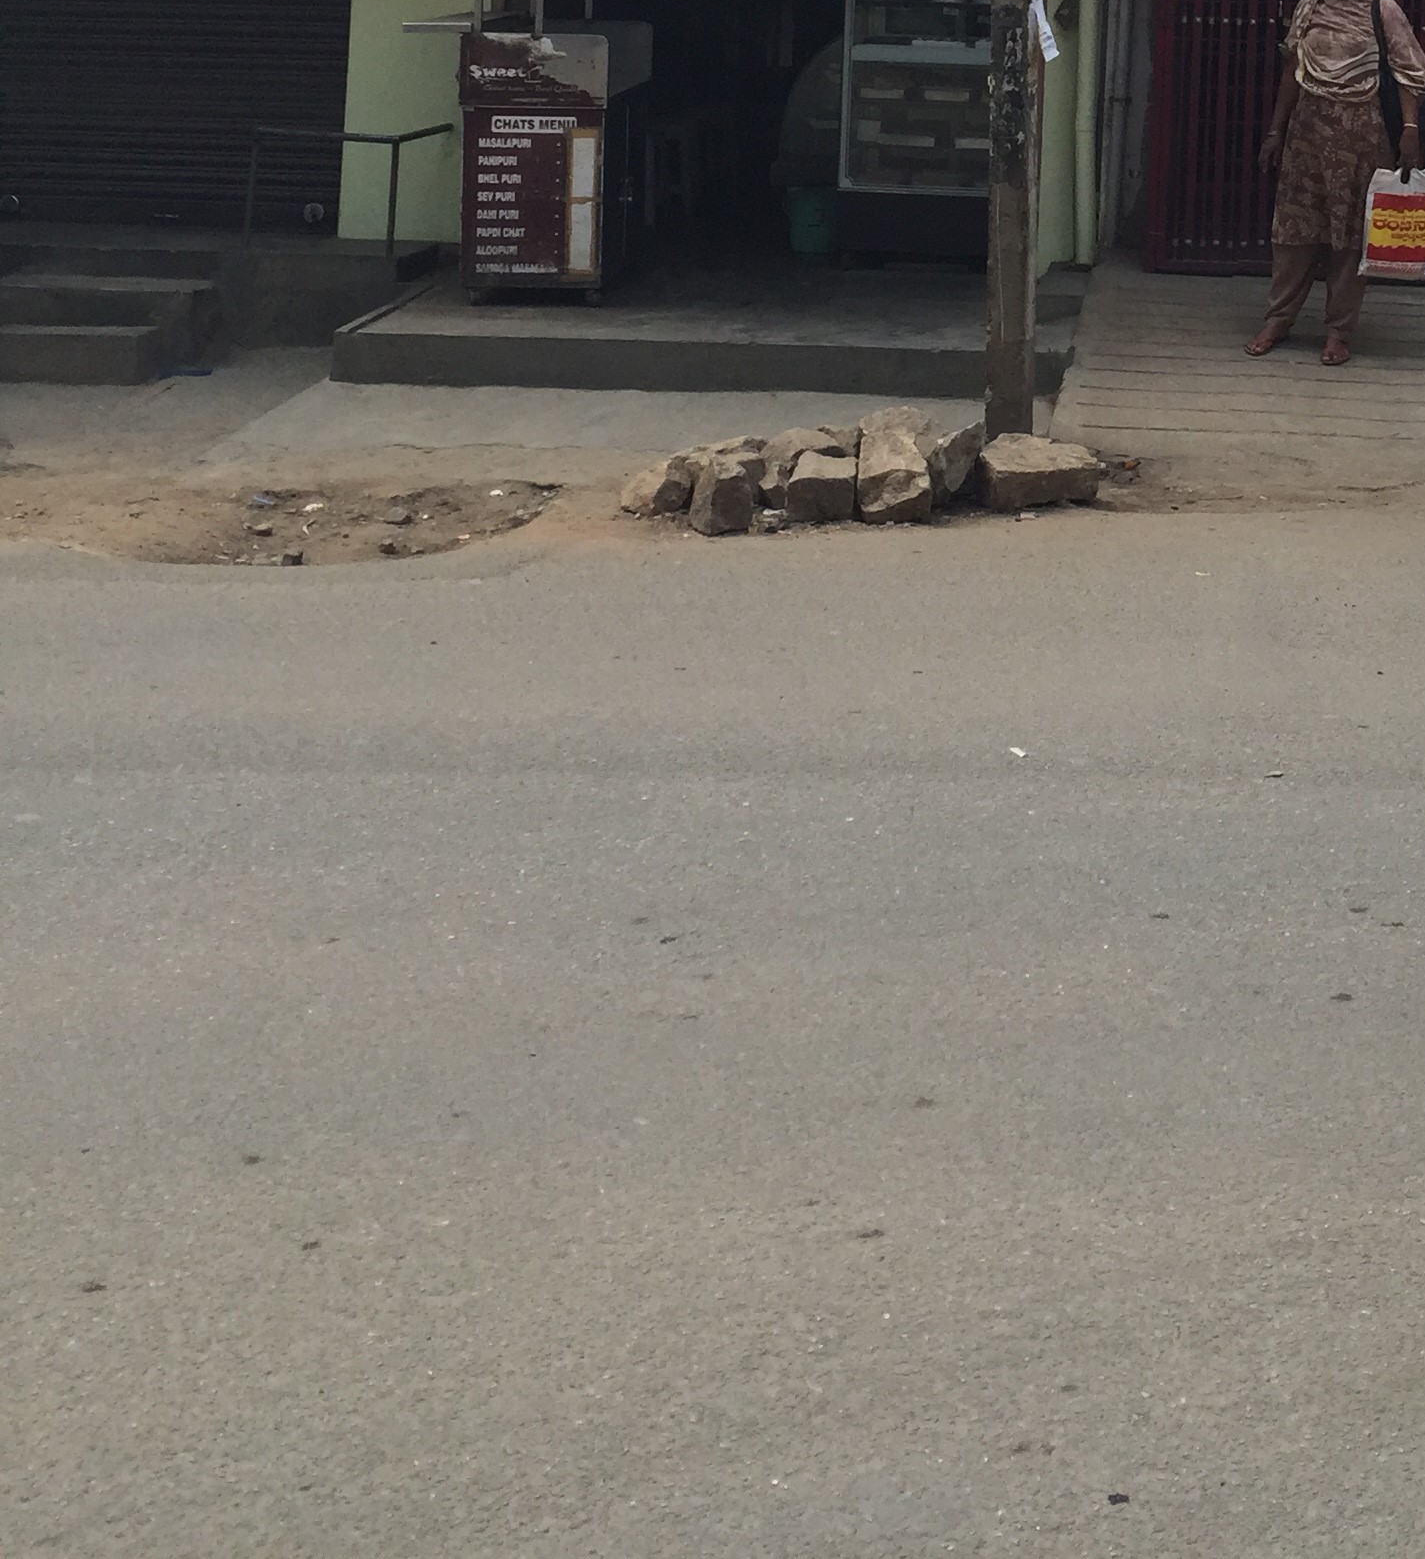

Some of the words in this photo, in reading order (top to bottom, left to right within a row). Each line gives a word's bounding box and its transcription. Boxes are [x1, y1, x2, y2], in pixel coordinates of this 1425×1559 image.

[494, 120, 535, 130] CHATS
[478, 138, 532, 149] MASALAPURI
[501, 174, 522, 184] PURI
[495, 192, 516, 202] PURI
[499, 210, 519, 220] PURI
